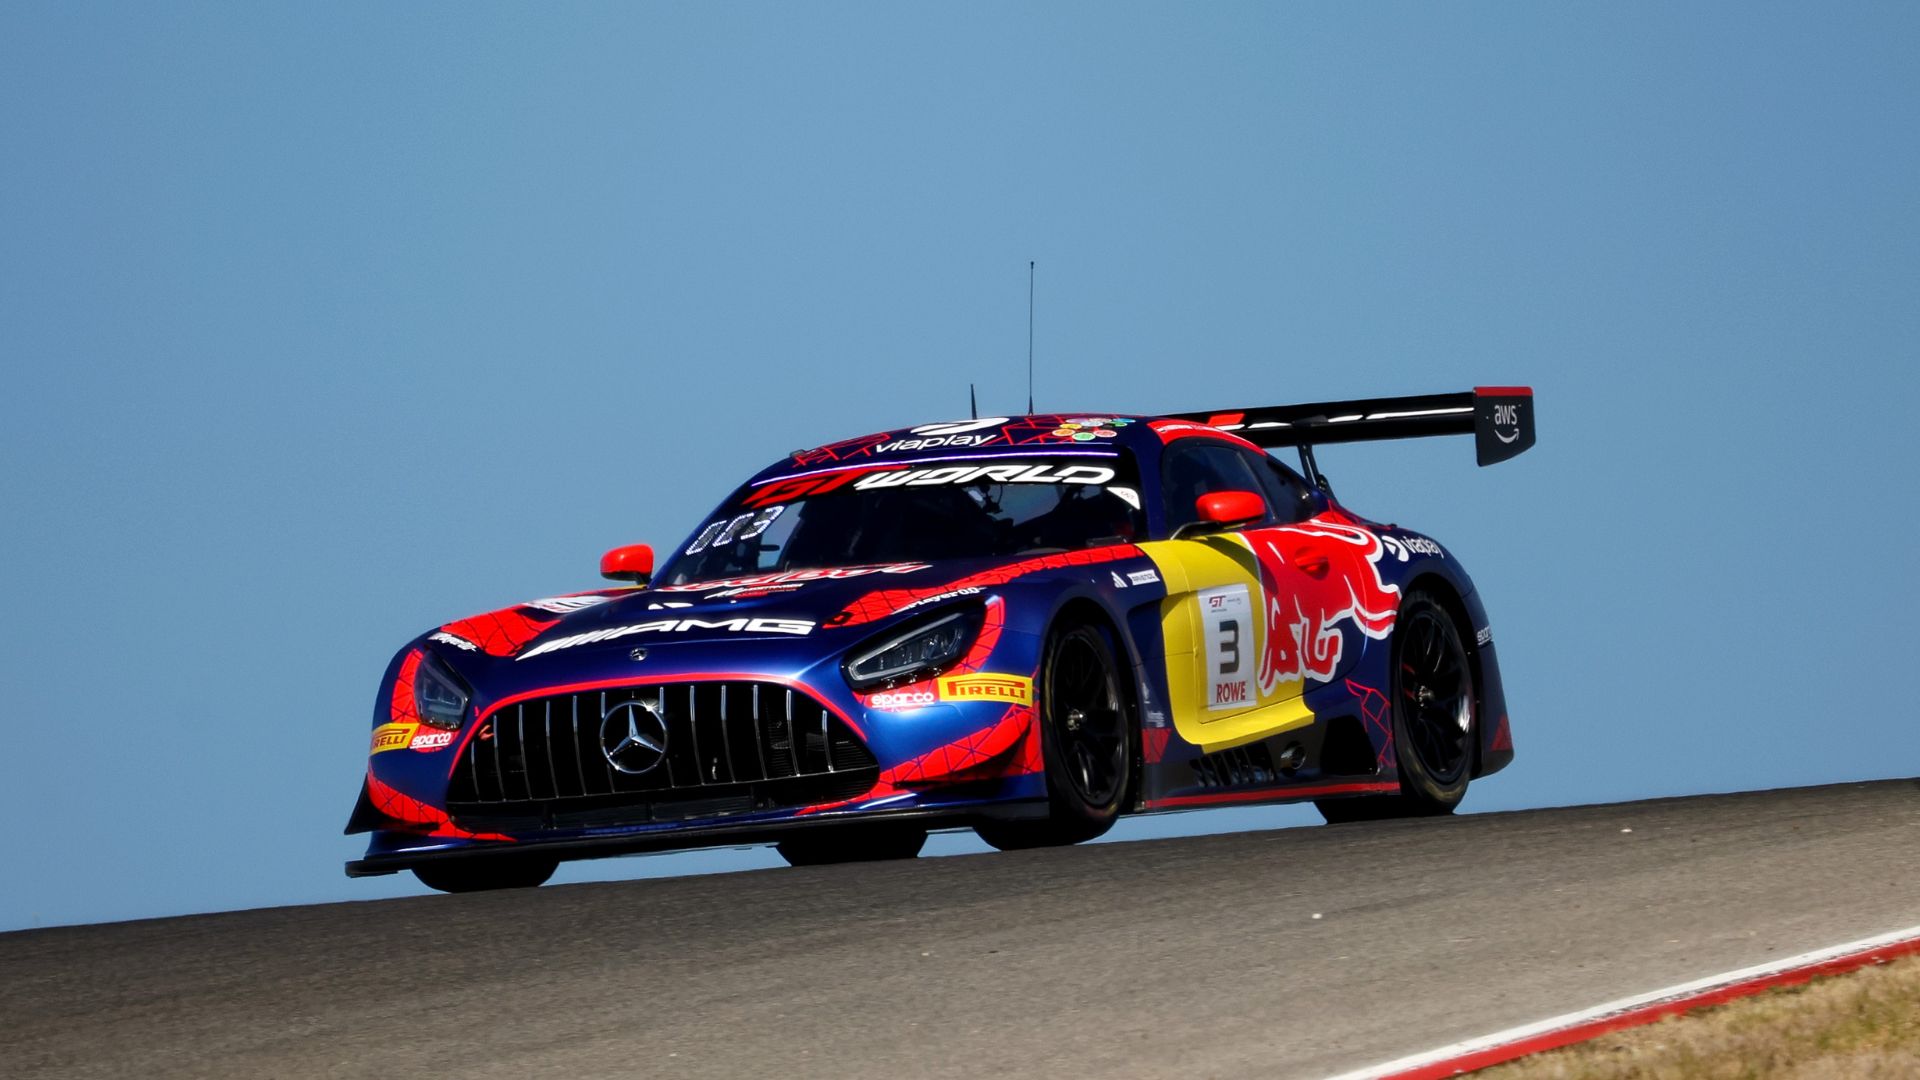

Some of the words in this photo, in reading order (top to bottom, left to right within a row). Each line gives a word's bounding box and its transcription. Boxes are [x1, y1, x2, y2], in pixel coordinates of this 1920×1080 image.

[1494, 404, 1518, 426] aws
[876, 434, 997, 453] viaplay
[741, 464, 911, 509] GT
[853, 465, 1115, 490] WORLD
[1219, 620, 1240, 674] 3
[871, 691, 935, 706] sparco
[946, 678, 1026, 700] PIRELLI
[1216, 681, 1246, 703] ROWE
[411, 732, 452, 747] sparco
